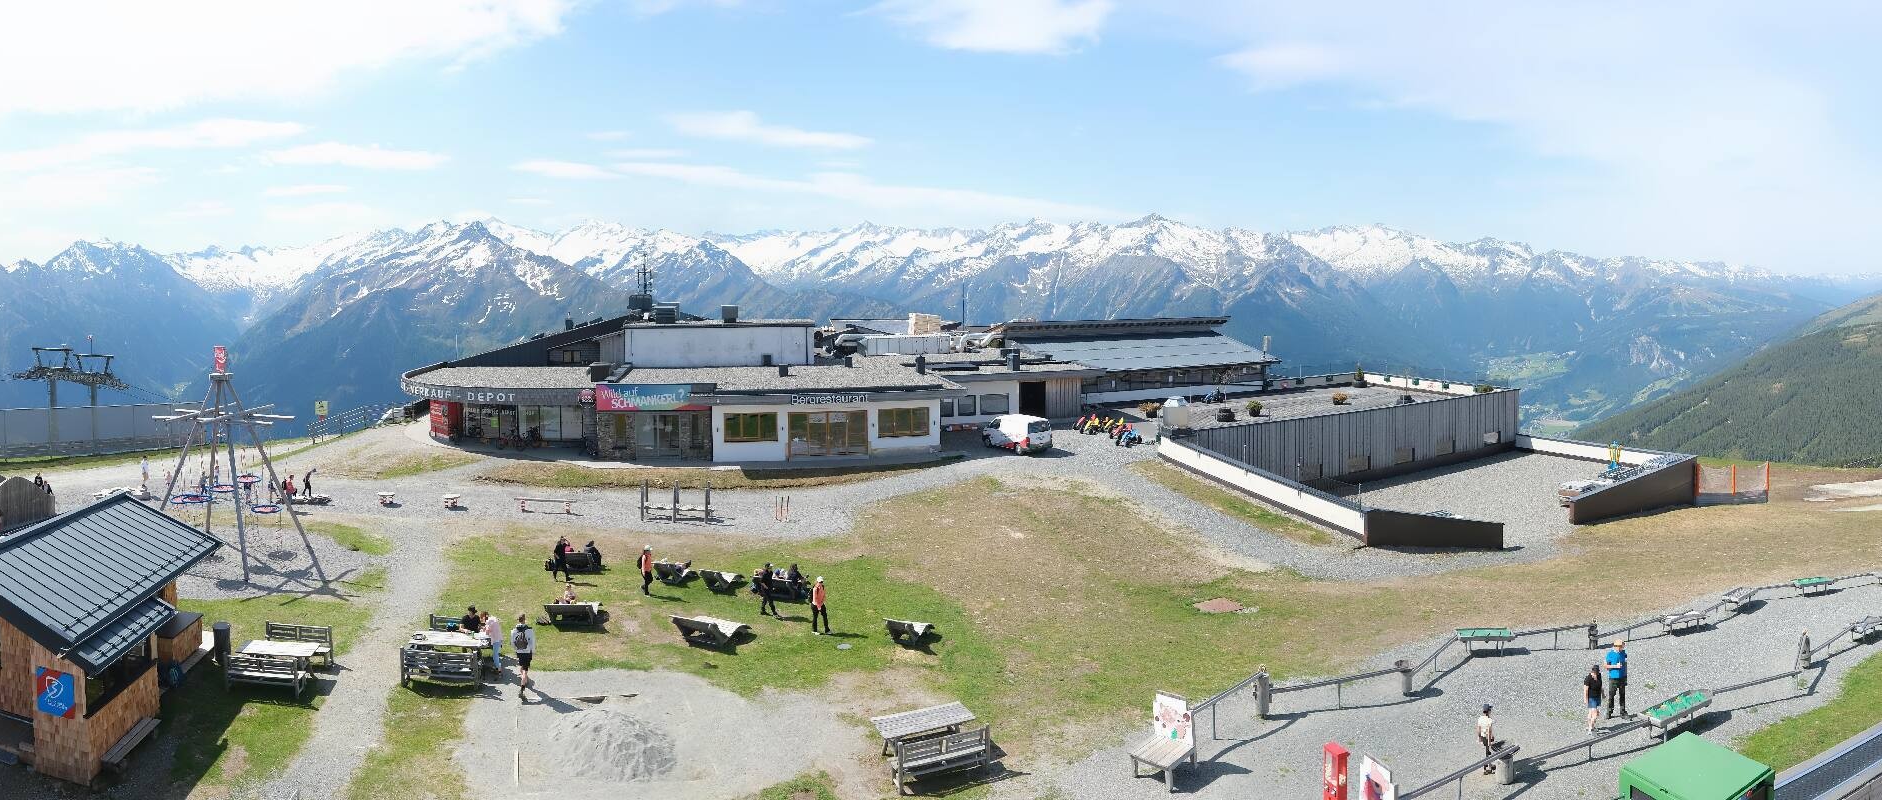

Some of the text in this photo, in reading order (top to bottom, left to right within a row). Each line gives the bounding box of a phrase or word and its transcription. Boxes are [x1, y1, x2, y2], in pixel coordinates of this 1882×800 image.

[467, 391, 516, 402] DEPOT
[601, 387, 621, 400] Wild
[623, 386, 638, 398] auf
[791, 394, 869, 405] Bergrestaurant
